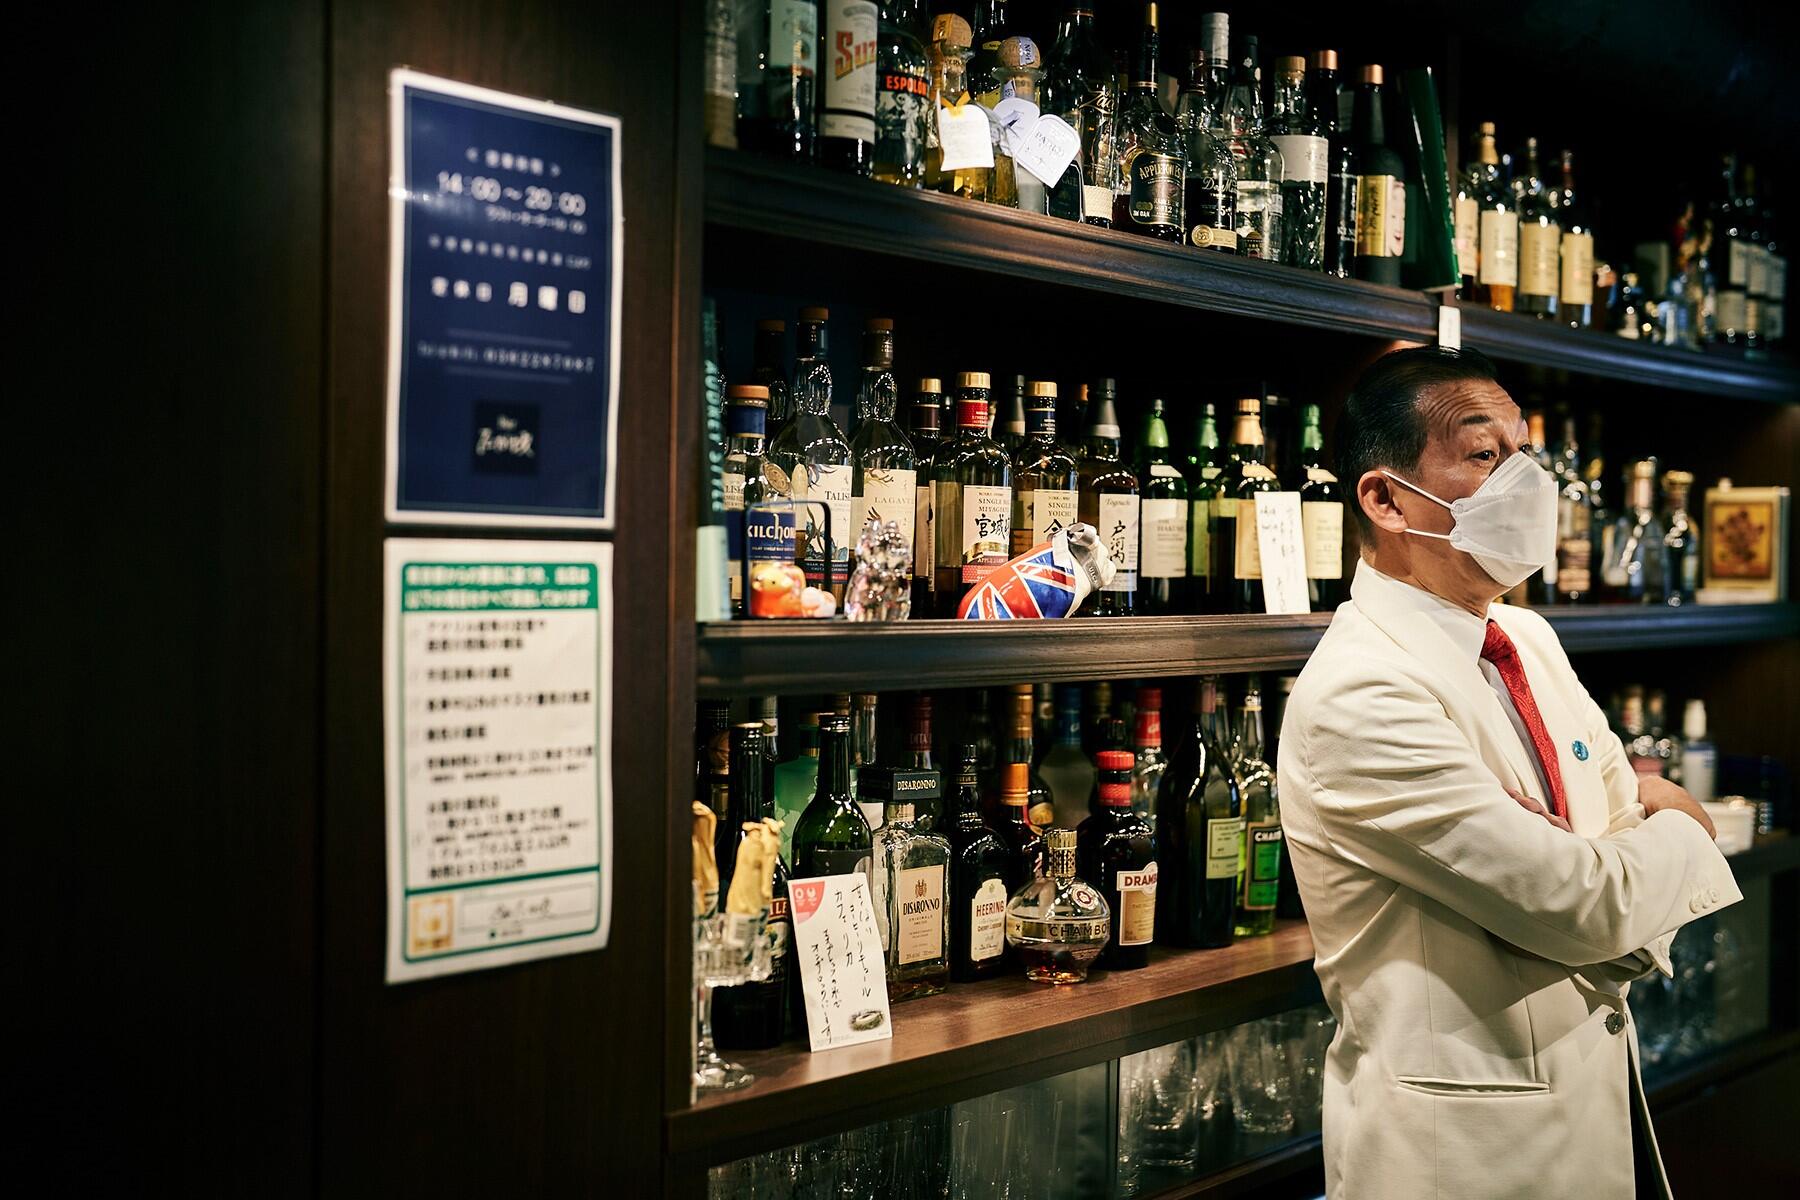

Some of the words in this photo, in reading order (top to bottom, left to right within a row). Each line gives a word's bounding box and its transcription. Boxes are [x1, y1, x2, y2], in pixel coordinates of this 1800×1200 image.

[897, 779, 937, 791] DISARONNO
[903, 898, 940, 916] DISARONNO
[976, 900, 1005, 918] HEERING
